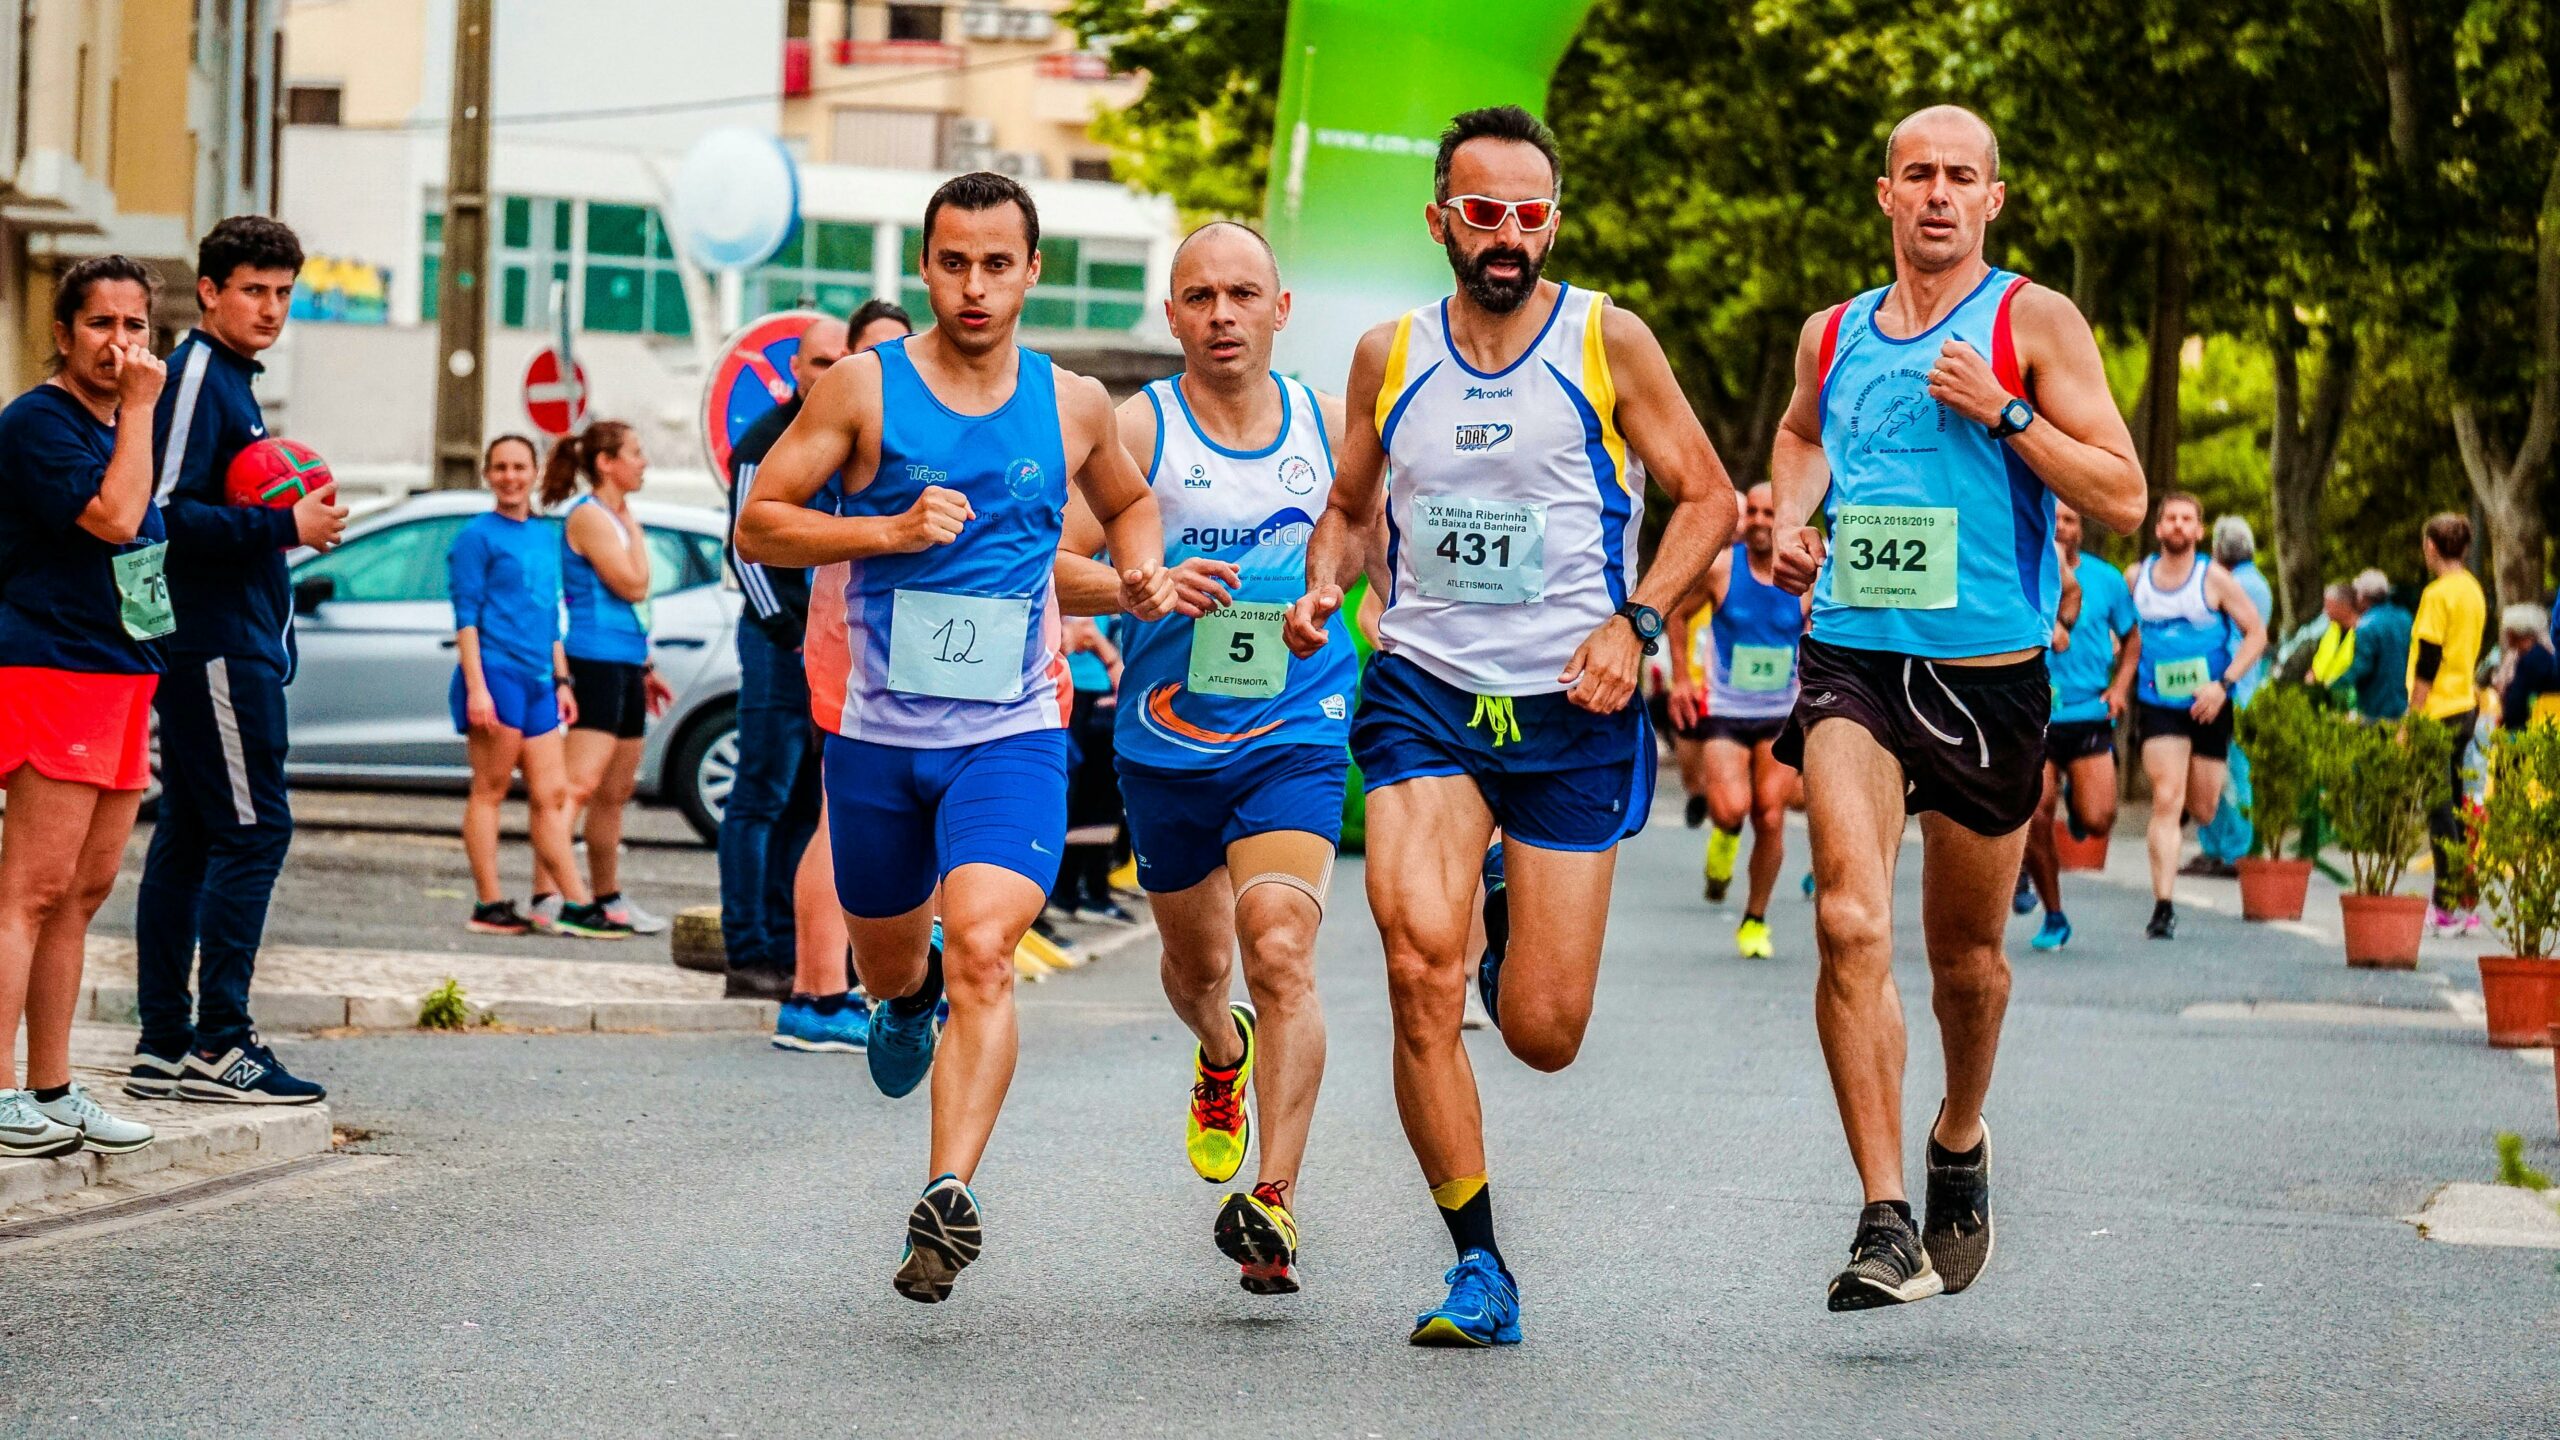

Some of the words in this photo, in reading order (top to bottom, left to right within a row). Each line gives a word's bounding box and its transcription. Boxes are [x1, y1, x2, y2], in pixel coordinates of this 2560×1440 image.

[1184, 478, 1212, 489] PLAY
[1428, 506, 1443, 516] XX
[1445, 507, 1473, 519] Milha
[1475, 509, 1528, 523] Riberinha
[1883, 516, 1935, 527] 2018/2019
[1428, 519, 1439, 527] da
[1441, 519, 1467, 529] Baixa
[1469, 521, 1481, 530] da
[1483, 521, 1527, 533] Banheira
[1436, 531, 1511, 568] 431
[1849, 538, 1927, 572] 342
[1446, 579, 1504, 591] ATLETISMOITA
[1859, 586, 1917, 596] ATLETISMOITA
[1205, 608, 1238, 619] POCA
[1240, 610, 1286, 622] 2018/201
[932, 617, 984, 664] 12
[1228, 631, 1255, 663] 5
[1207, 675, 1269, 687] ATLETISMOITA
